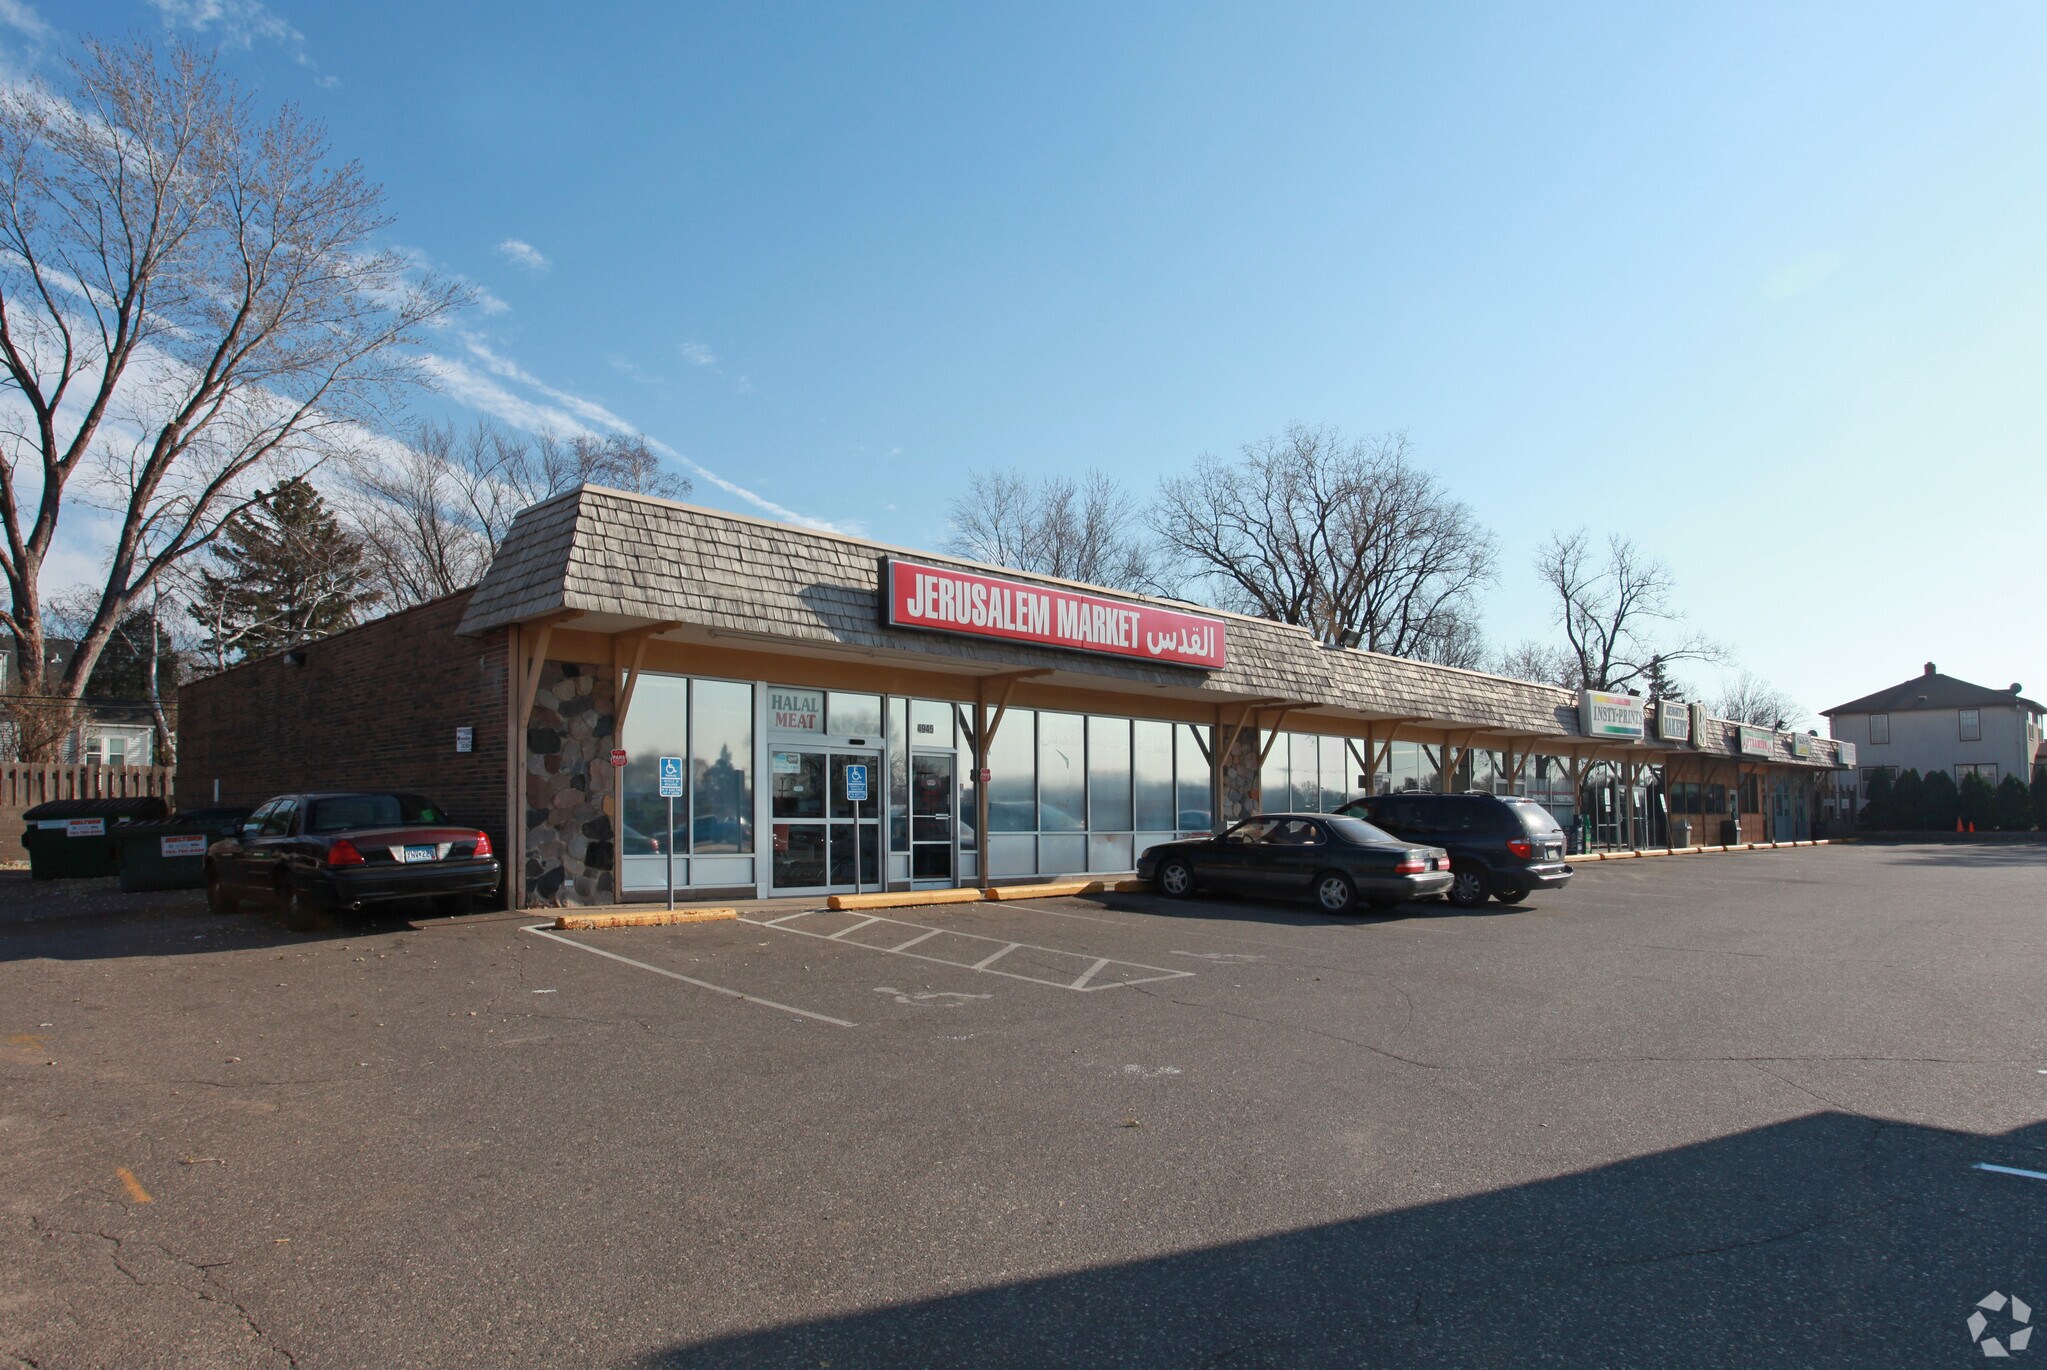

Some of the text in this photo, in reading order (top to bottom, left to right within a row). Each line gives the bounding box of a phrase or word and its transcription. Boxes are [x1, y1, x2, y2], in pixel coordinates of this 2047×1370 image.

[907, 573, 1140, 649] JERUSALEM MARKET
[1146, 625, 1215, 659] القدس
[771, 694, 819, 712] HALAL
[775, 712, 816, 729] MEAT
[917, 724, 934, 734] 4945
[1664, 717, 1688, 738] BAKERY
